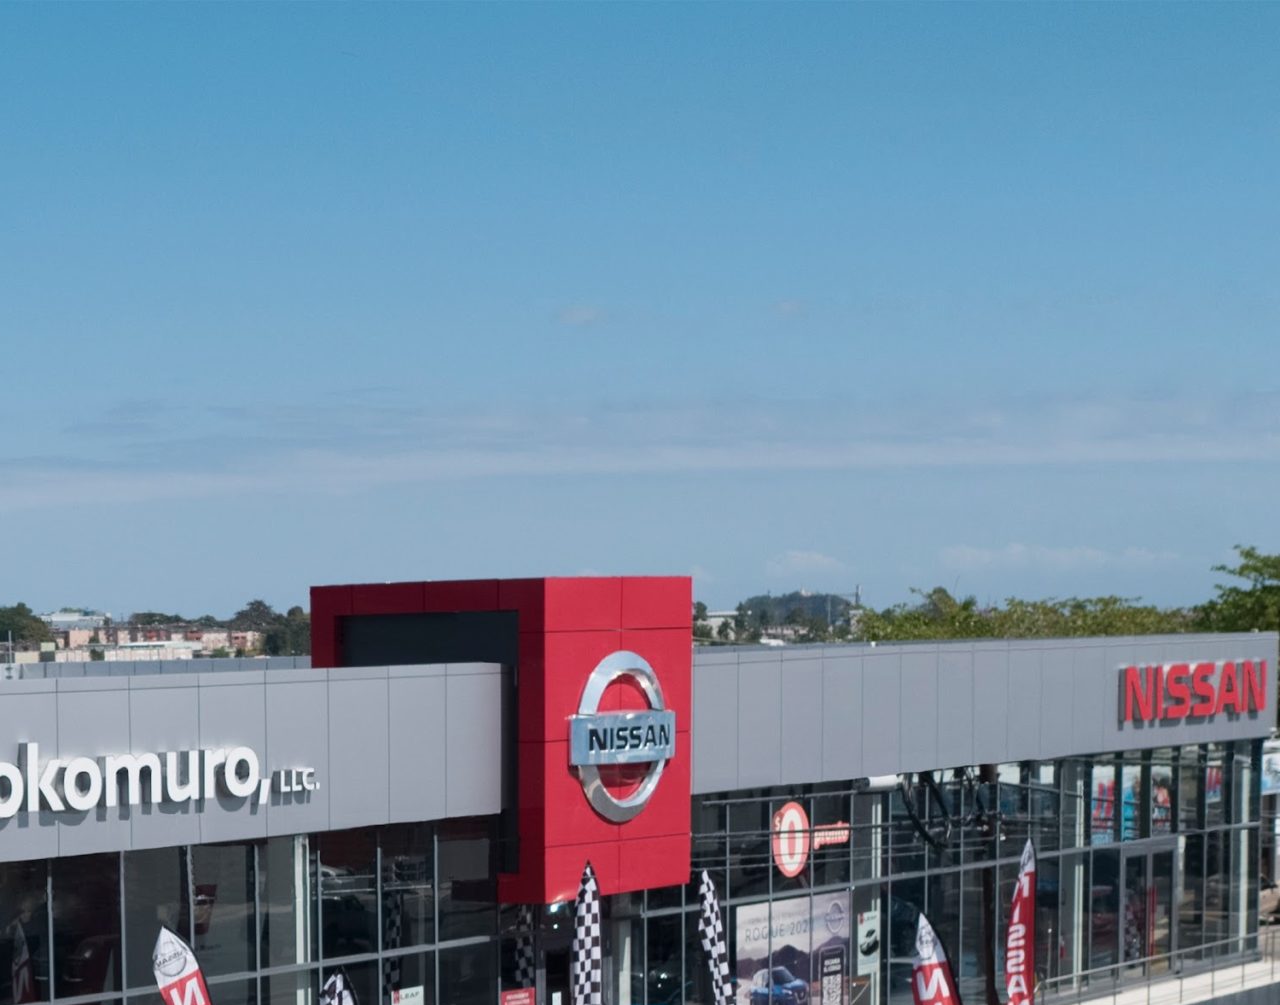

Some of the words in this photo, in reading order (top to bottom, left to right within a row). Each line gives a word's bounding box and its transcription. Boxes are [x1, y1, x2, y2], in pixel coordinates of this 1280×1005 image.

[1124, 659, 1268, 722] NISSAN
[588, 723, 671, 752] NISSAN
[279, 766, 321, 793] LLC.
[789, 919, 812, 936] 202
